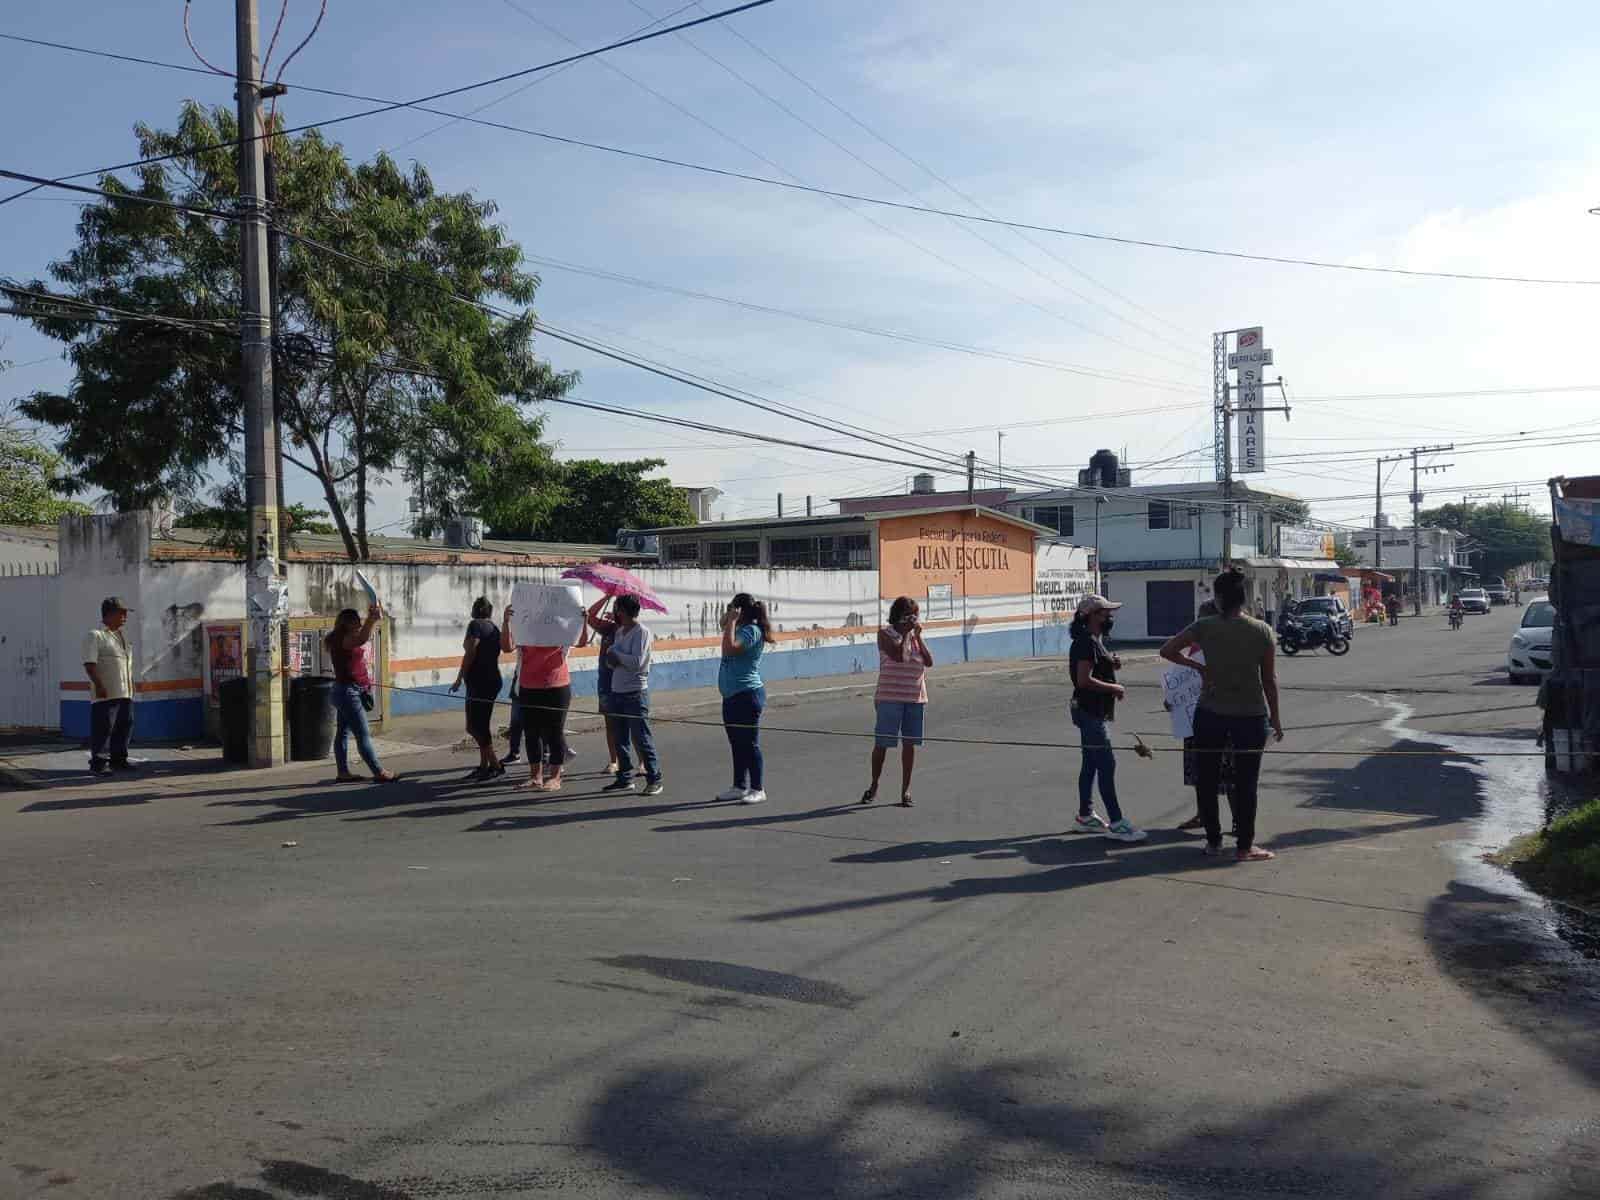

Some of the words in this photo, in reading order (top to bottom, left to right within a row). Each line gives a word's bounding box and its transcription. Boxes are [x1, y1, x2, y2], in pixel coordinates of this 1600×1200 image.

[913, 545, 953, 570] JUAN
[955, 545, 1009, 570] ESCUTIA
[1035, 580, 1063, 595] MIGUEL
[1065, 580, 1094, 595] HIDALGO
[1042, 598, 1048, 611] Y
[1050, 597, 1079, 611] COSTILL
